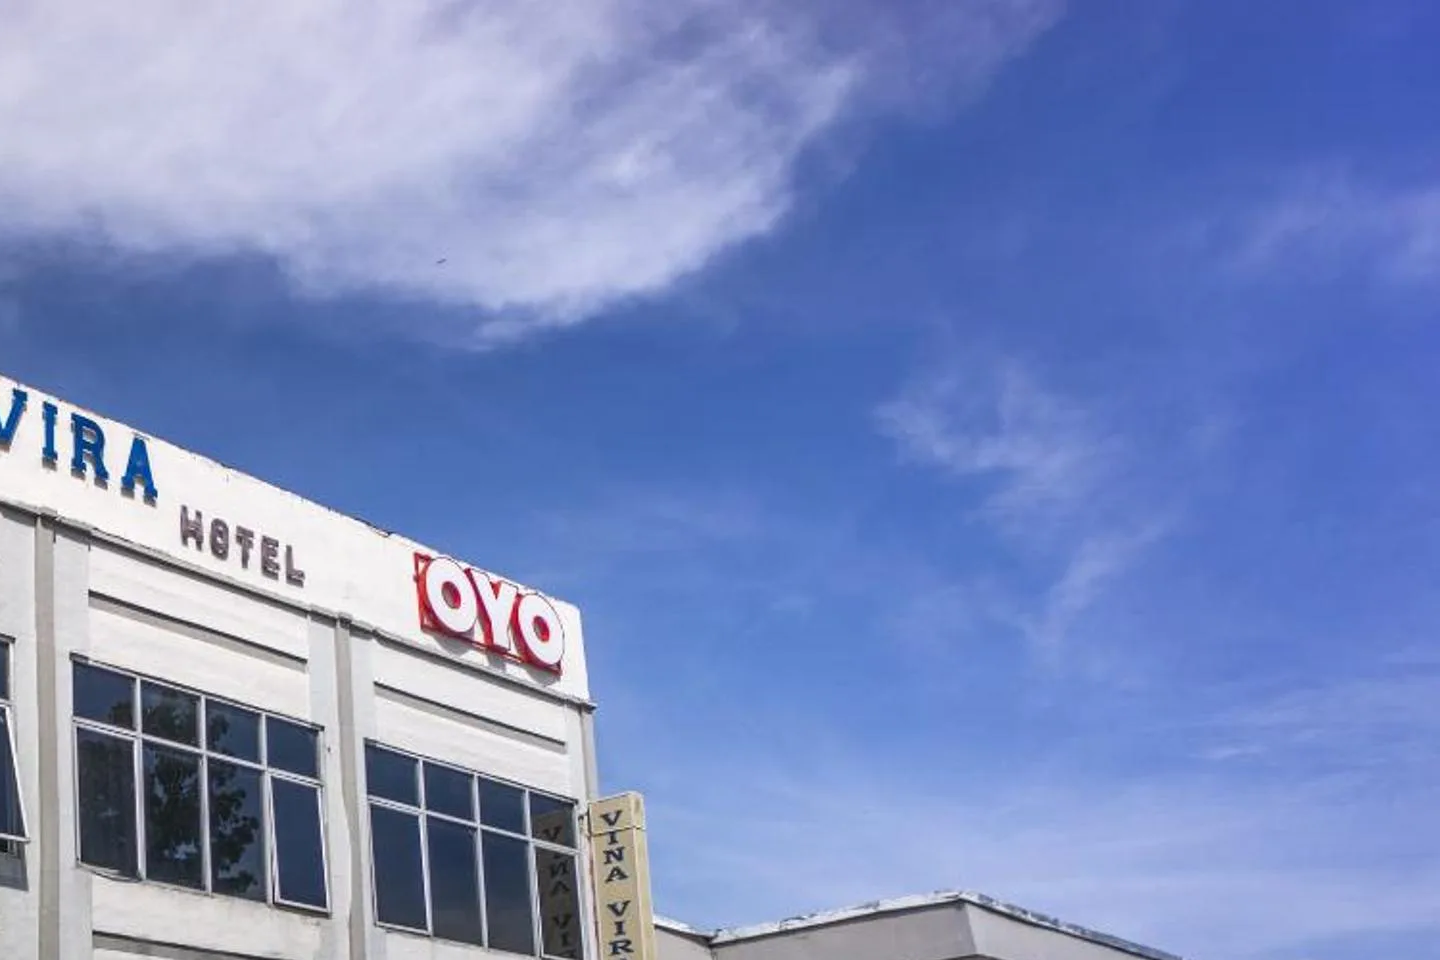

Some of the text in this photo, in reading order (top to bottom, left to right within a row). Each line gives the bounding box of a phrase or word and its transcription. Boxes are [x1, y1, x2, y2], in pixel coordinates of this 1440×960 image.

[180, 506, 305, 586] HOTEL
[424, 556, 565, 667] OYO
[600, 809, 639, 884] VINA
